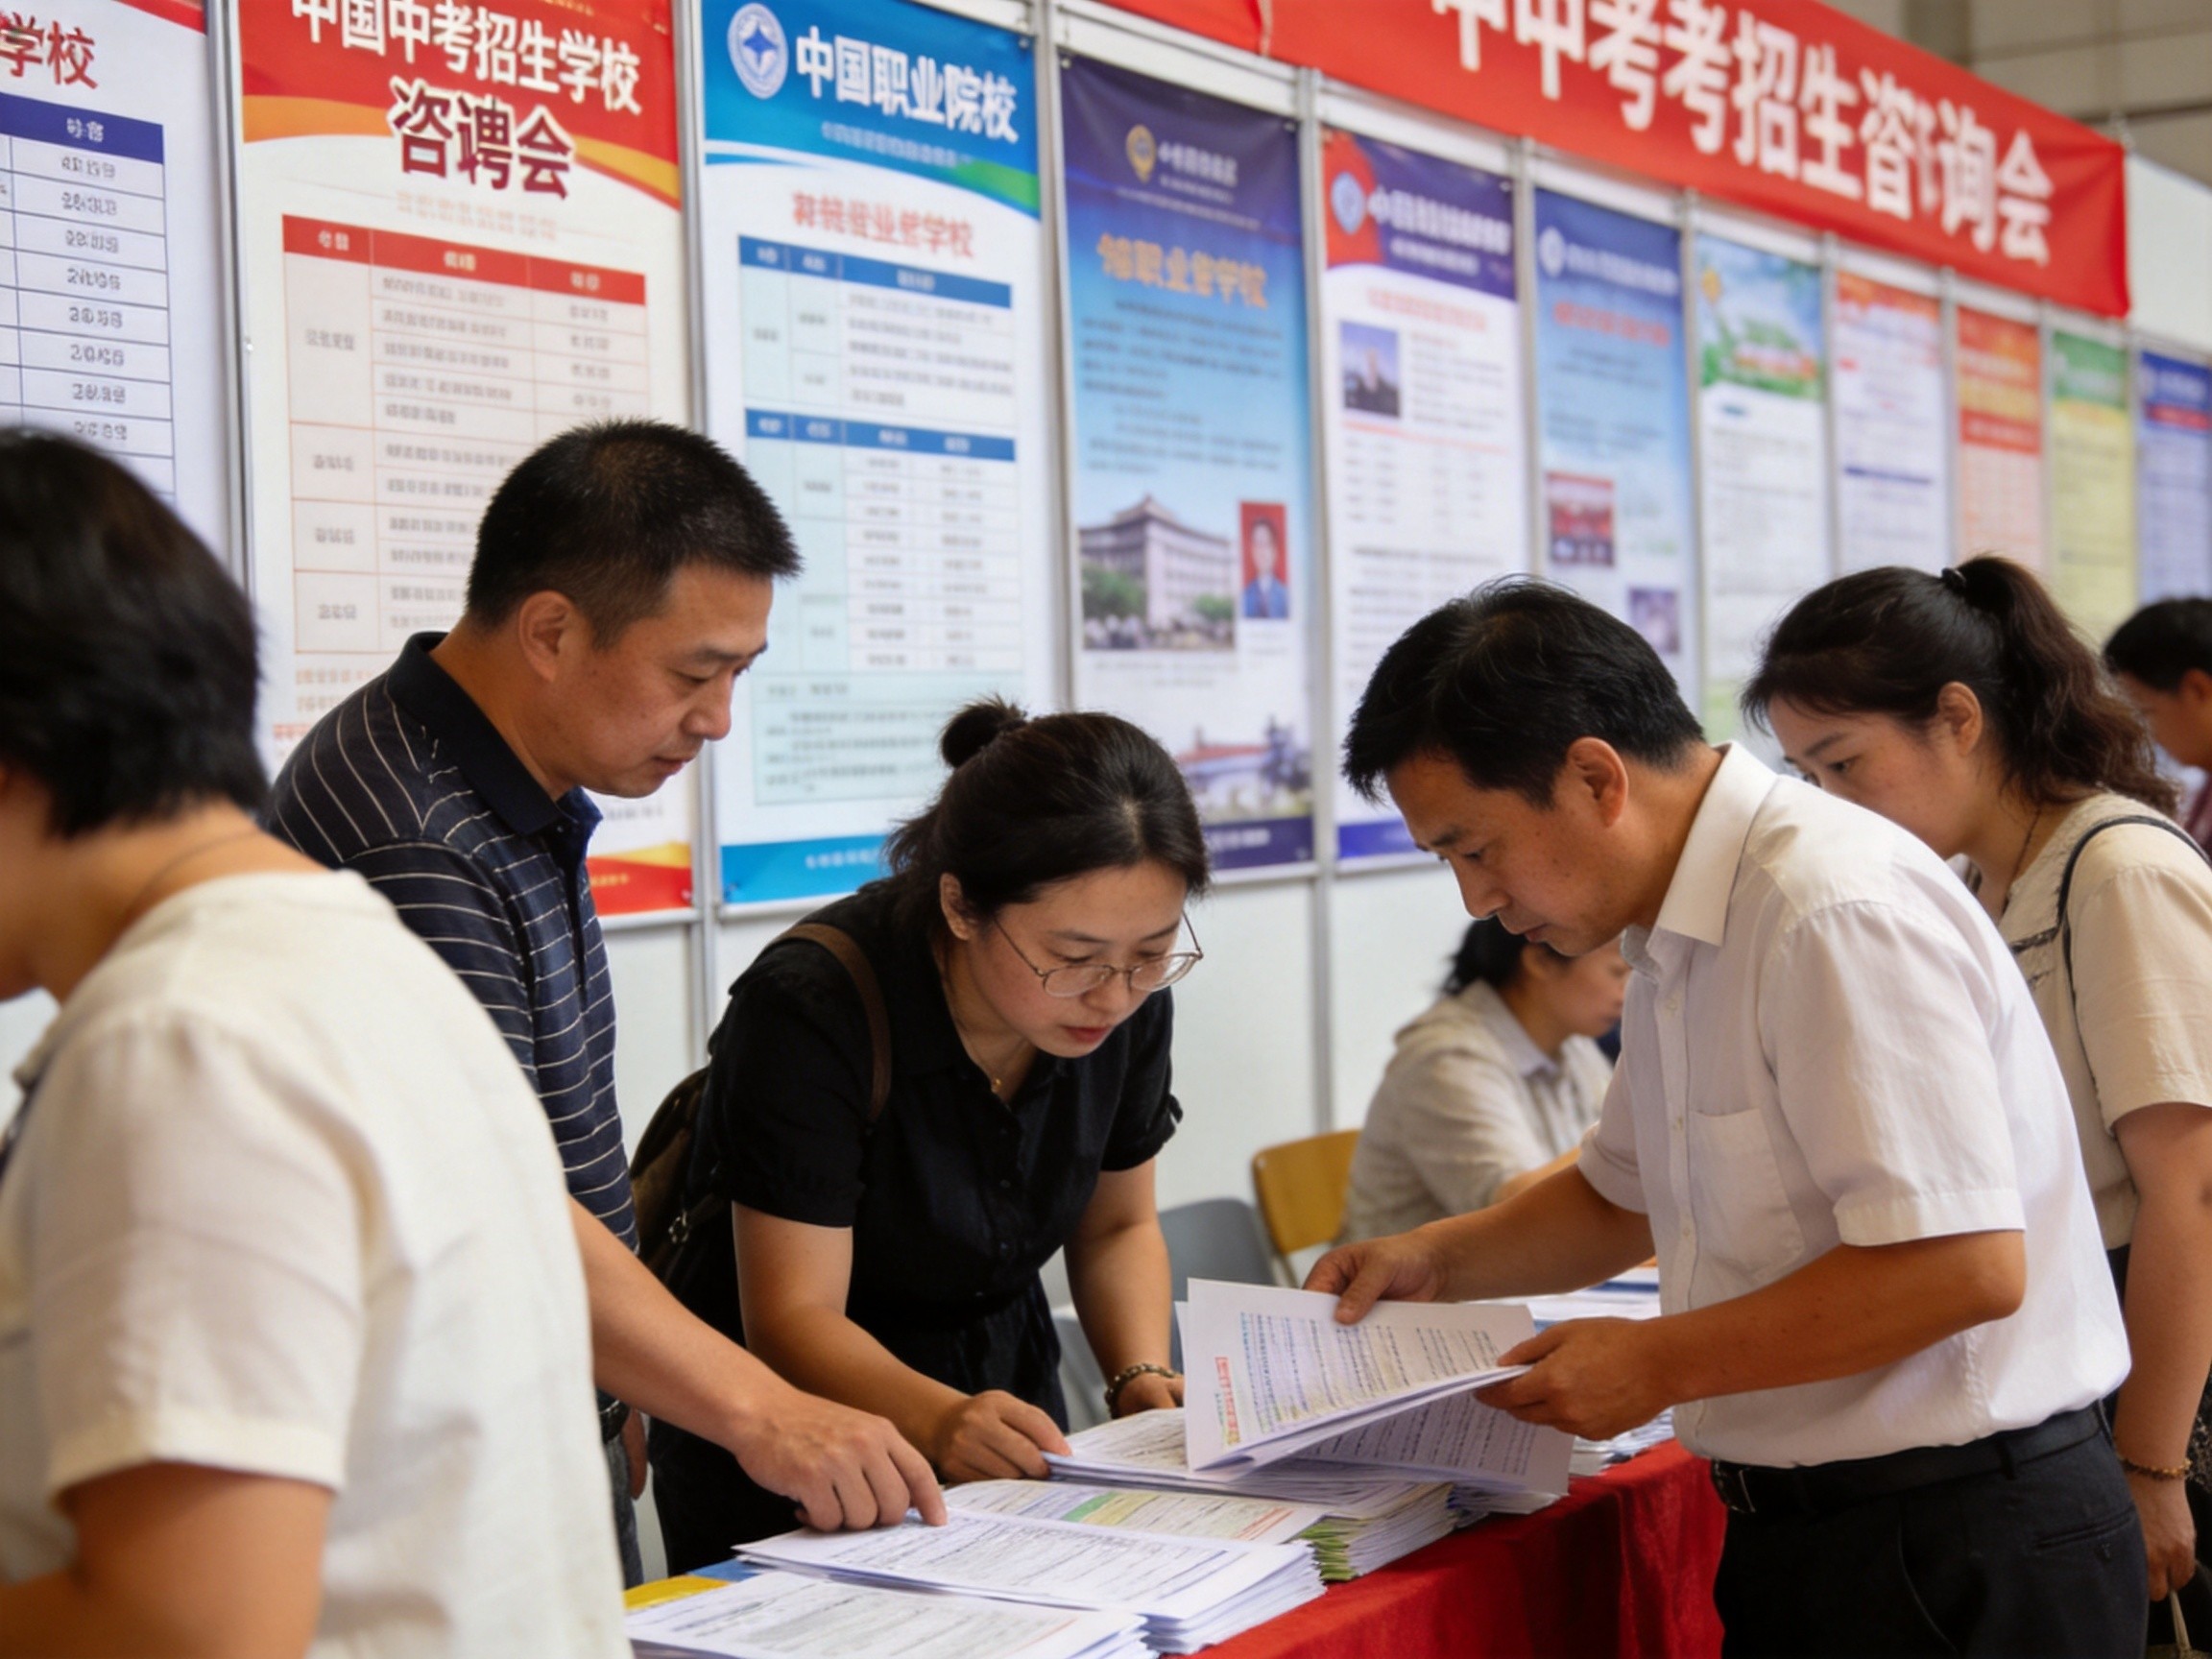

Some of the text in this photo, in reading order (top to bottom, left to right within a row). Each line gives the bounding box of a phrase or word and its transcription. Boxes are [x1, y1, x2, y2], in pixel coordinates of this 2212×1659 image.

[0, 12, 98, 89] 学校
[291, 0, 642, 116] 中国中考招生学校
[796, 25, 1019, 144] 中国职业院校
